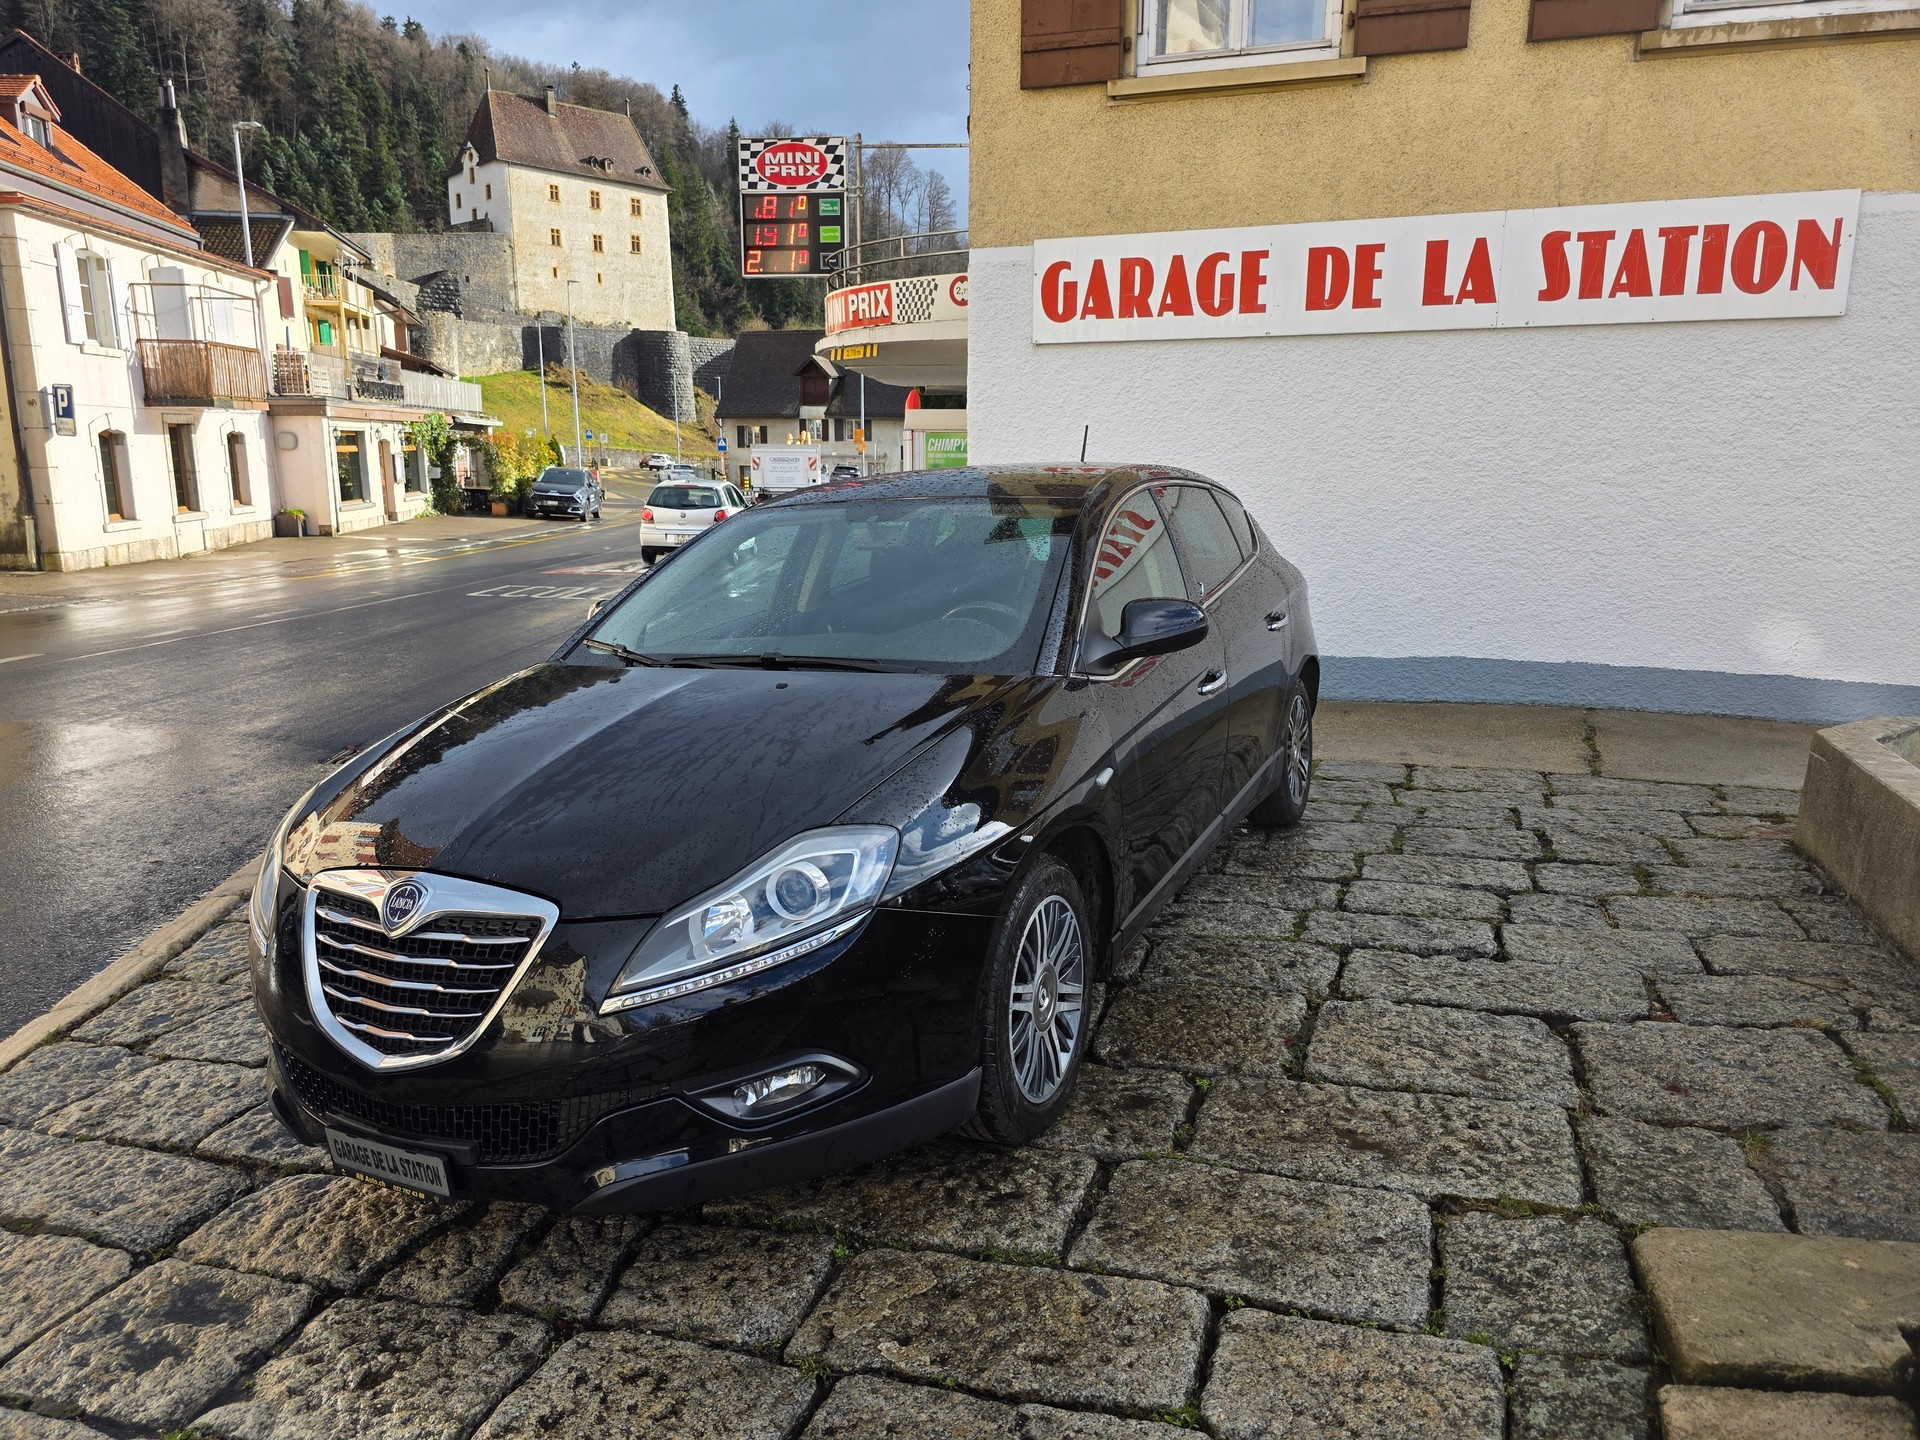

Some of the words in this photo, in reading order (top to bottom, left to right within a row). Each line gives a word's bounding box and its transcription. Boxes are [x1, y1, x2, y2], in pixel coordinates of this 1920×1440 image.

[764, 151, 820, 165] MINI
[764, 164, 821, 177] PRIX
[1040, 249, 1270, 324] GARAGE
[1304, 243, 1386, 312] DE
[1421, 237, 1498, 307] LA
[1537, 217, 1844, 303] STATION
[848, 288, 890, 322] PRIX
[57, 388, 69, 416] P
[928, 438, 968, 452] CHIMPY
[390, 896, 414, 910] LANCIA
[333, 1138, 371, 1167] GARAGE
[372, 1151, 387, 1171] DE
[385, 1154, 400, 1175] LA
[399, 1159, 443, 1187] STATION
